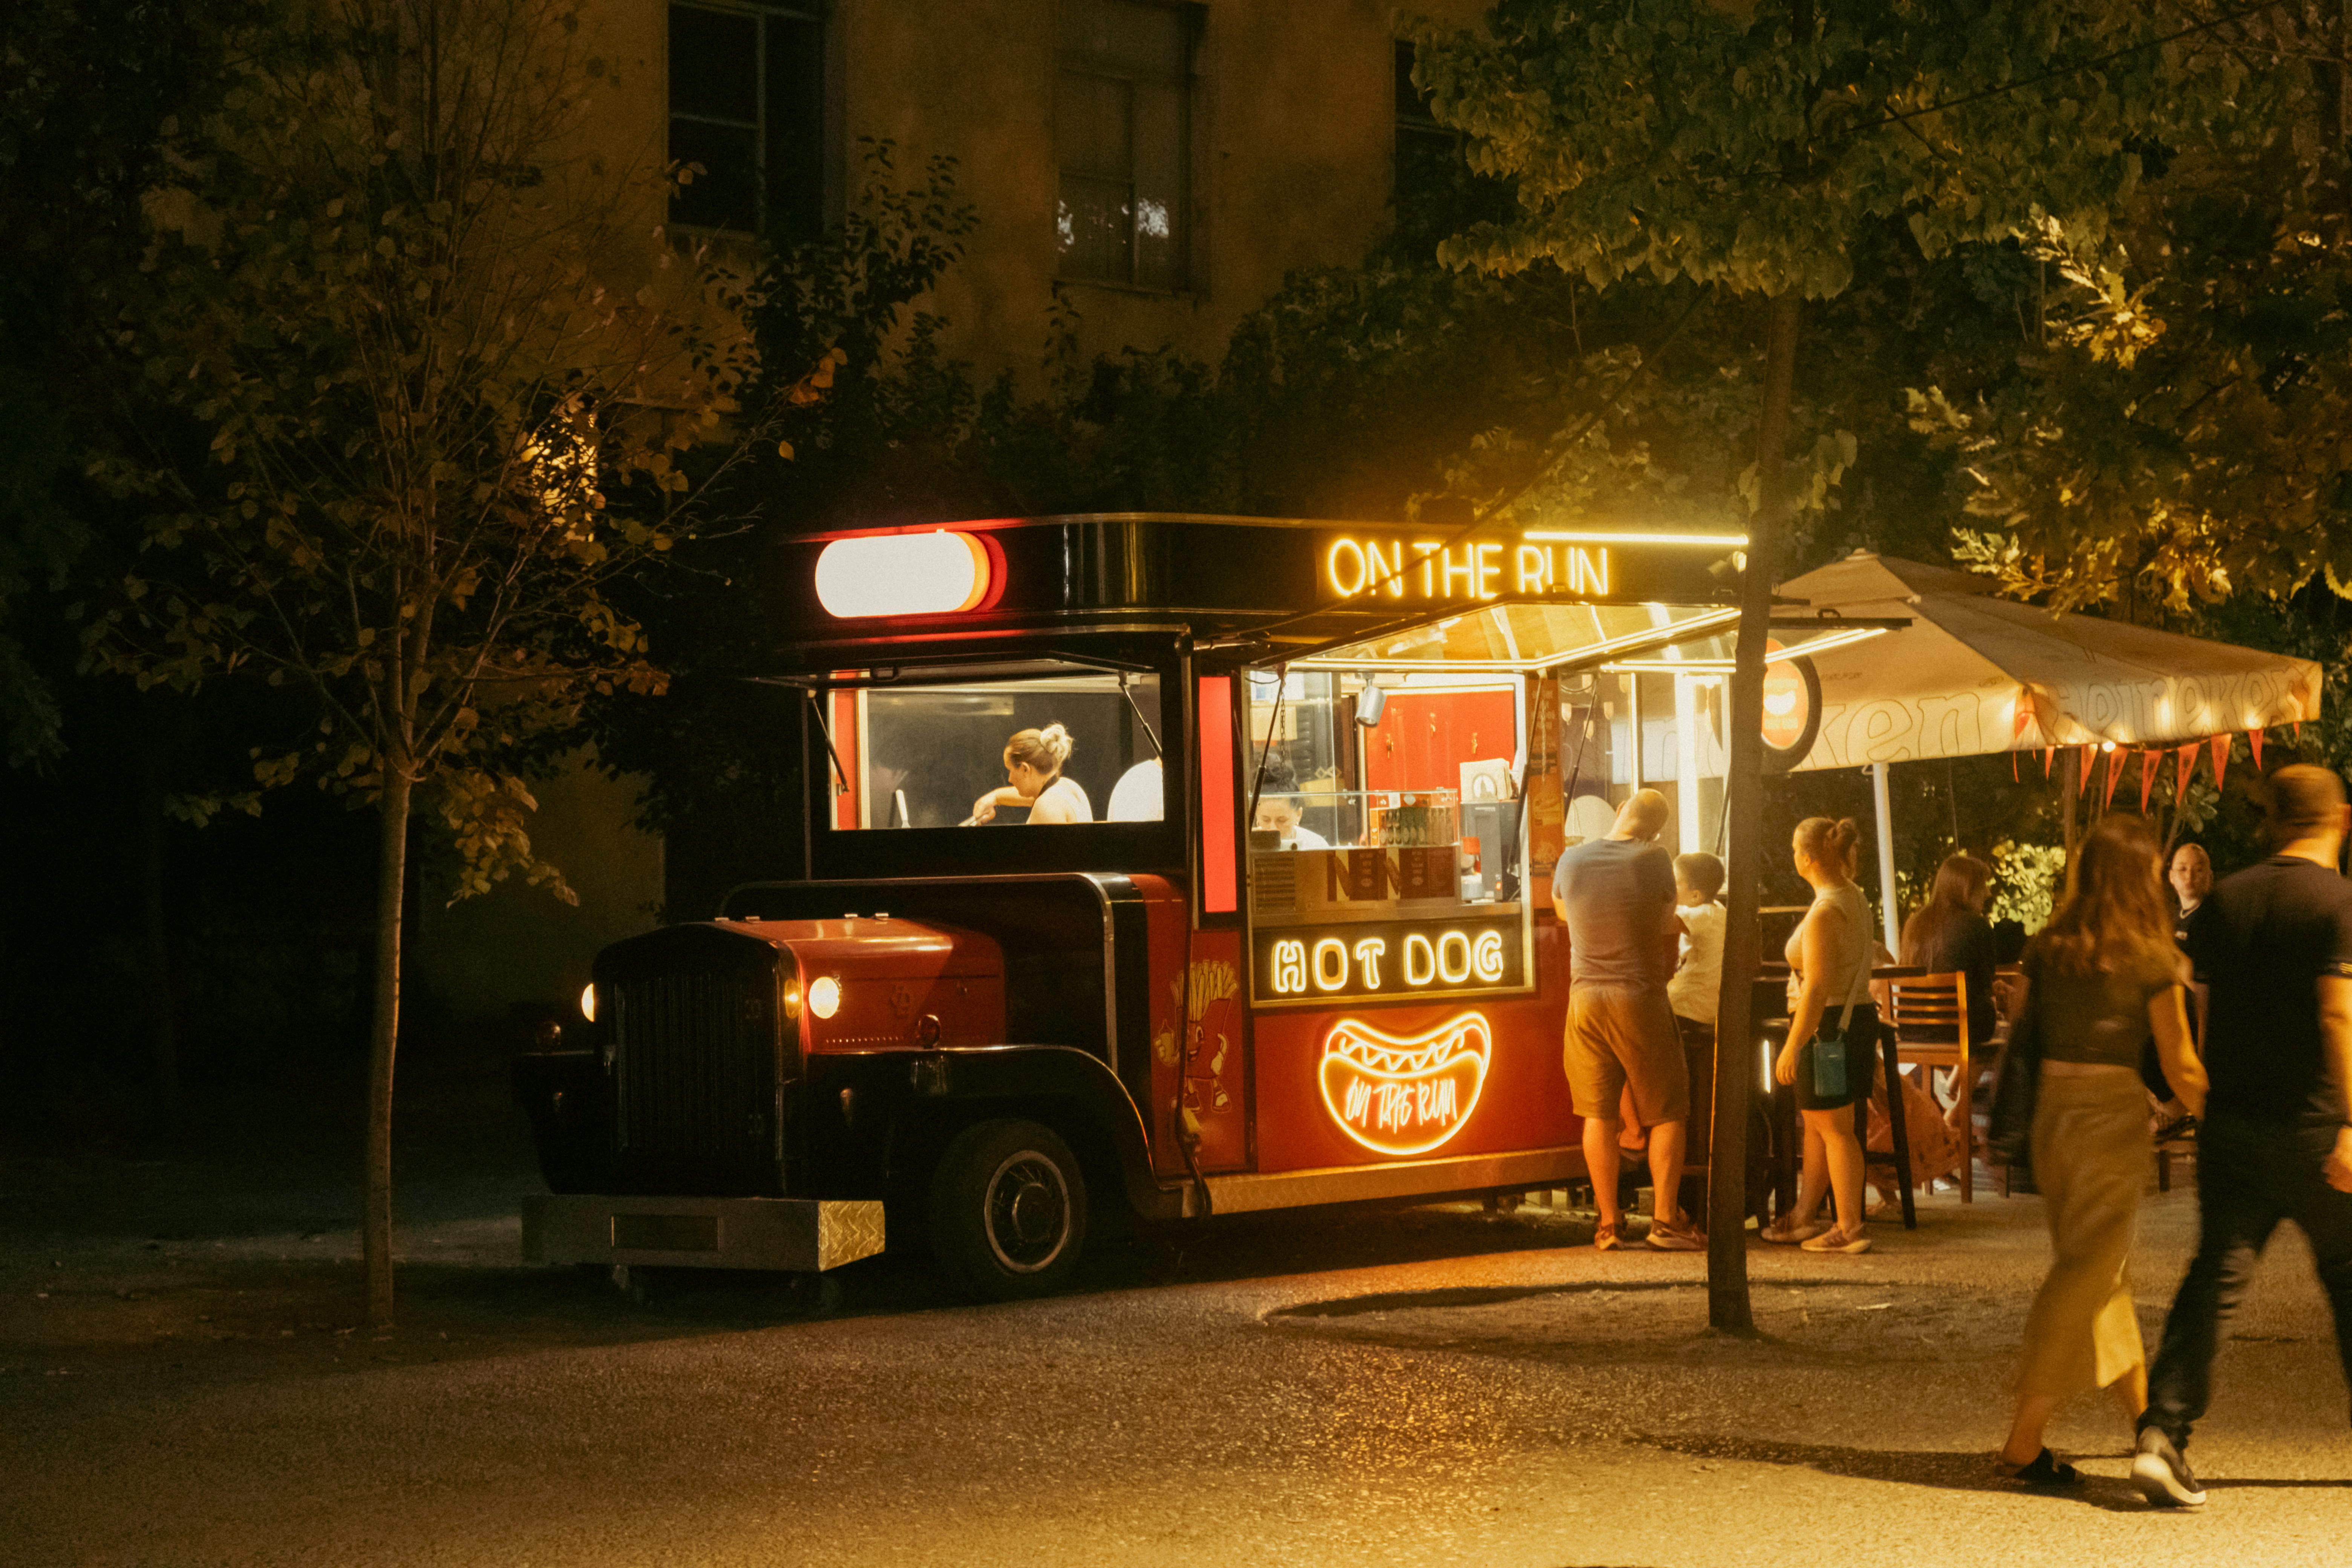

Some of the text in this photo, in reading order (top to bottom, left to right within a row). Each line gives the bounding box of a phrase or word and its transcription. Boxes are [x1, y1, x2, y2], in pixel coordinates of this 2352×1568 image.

[1327, 538, 1608, 599] ON THE RUN
[1271, 930, 1504, 993] HOT DOG
[1345, 1075, 1458, 1134] ON THE RUN
